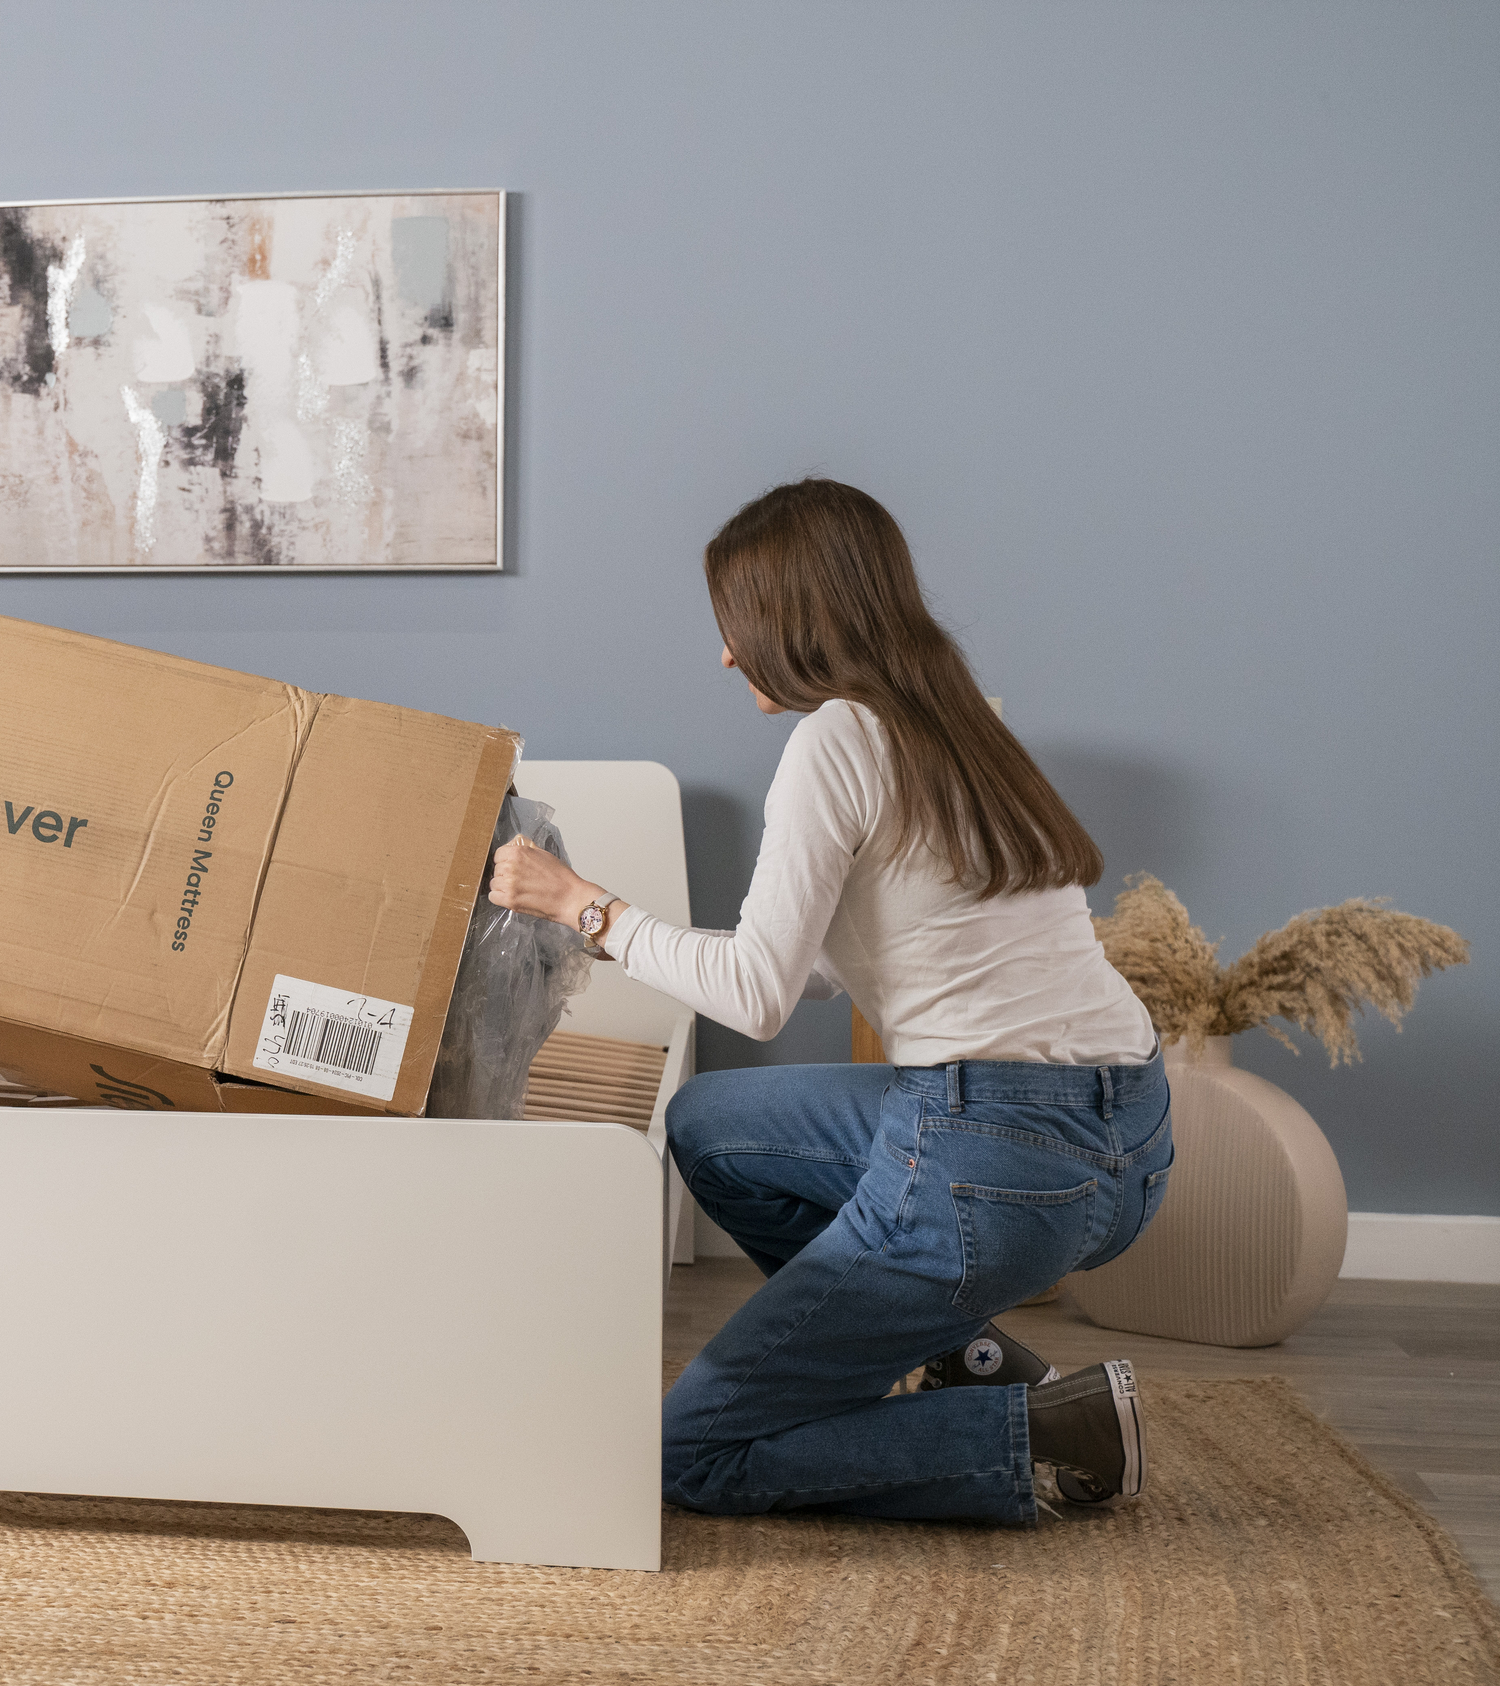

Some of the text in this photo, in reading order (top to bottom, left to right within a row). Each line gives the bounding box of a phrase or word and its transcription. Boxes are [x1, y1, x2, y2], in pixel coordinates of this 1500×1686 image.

[170, 770, 234, 953] Queen Mattress
[967, 1341, 991, 1361] CONVERSE
[989, 1356, 1000, 1371] STAR
[1111, 1364, 1125, 1395] CONVERSE
